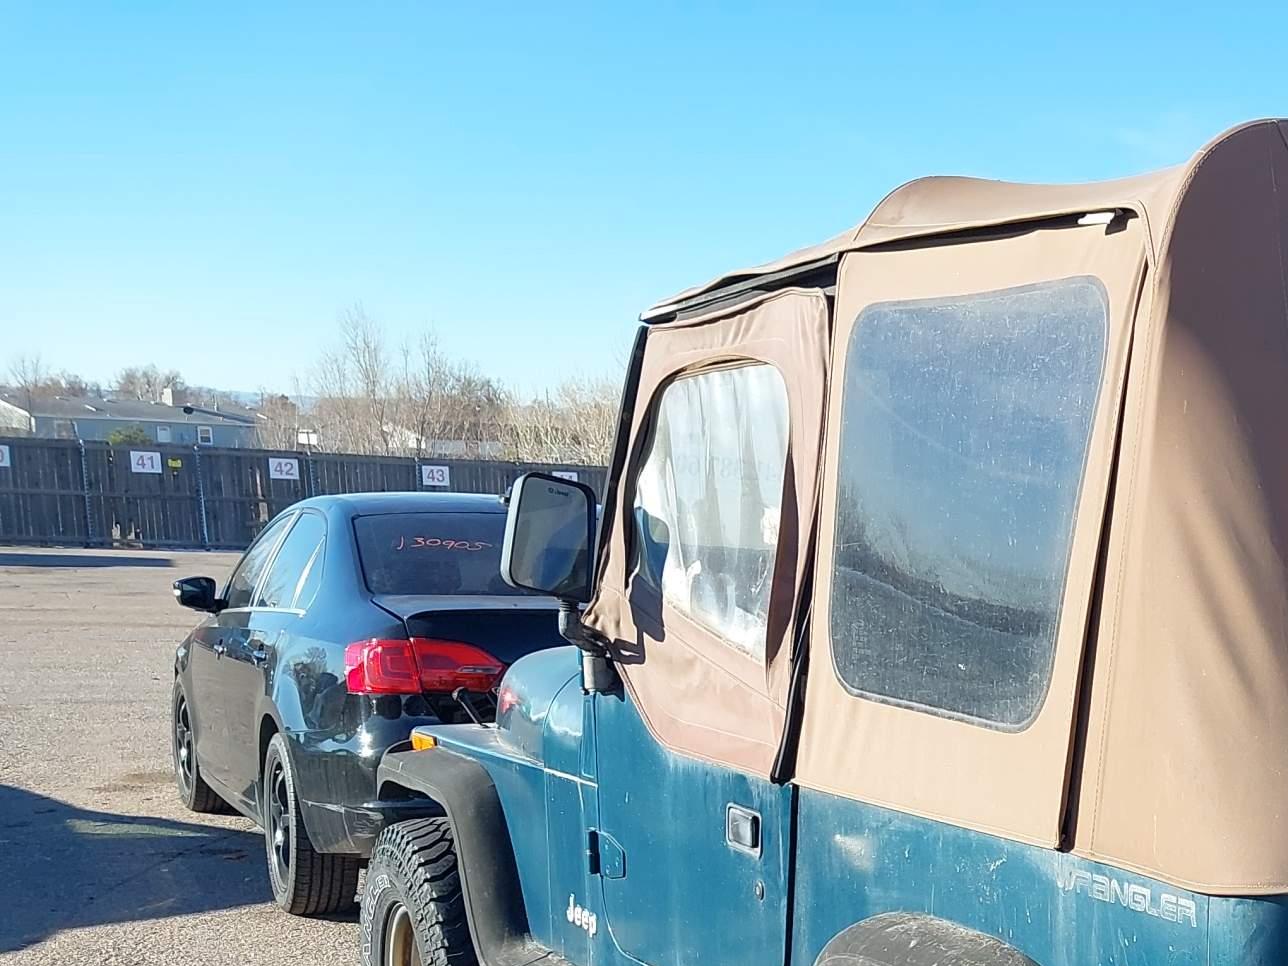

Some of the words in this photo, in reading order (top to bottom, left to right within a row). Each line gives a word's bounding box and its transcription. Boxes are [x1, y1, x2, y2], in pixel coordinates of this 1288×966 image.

[136, 455, 155, 469] 41
[273, 462, 294, 476] 42
[427, 469, 445, 482] 43
[1054, 861, 1197, 927] WRANGLER
[566, 893, 597, 938] Jeep
